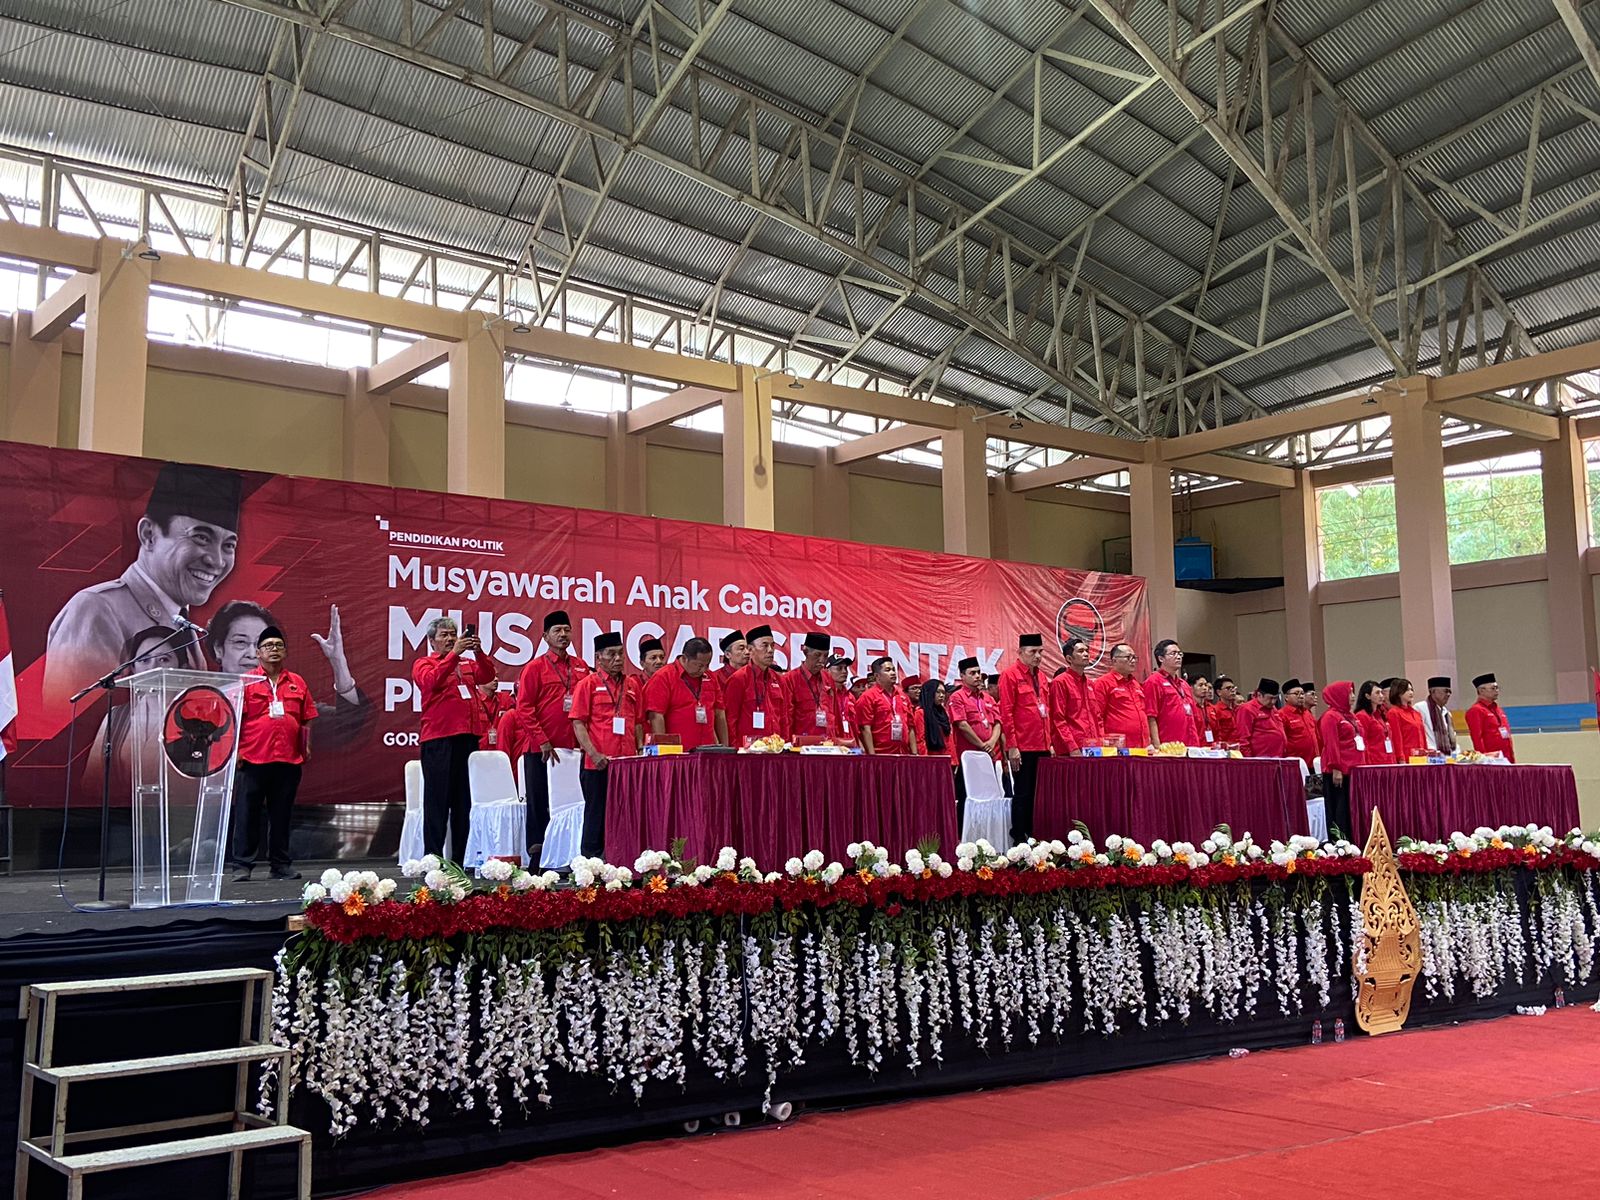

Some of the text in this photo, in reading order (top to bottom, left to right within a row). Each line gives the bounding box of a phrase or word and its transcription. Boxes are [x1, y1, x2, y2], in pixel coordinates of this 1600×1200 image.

[389, 531, 504, 551] PENDIDIKAN POLITIK
[388, 555, 832, 627] Musyawarah Anak Cabang
